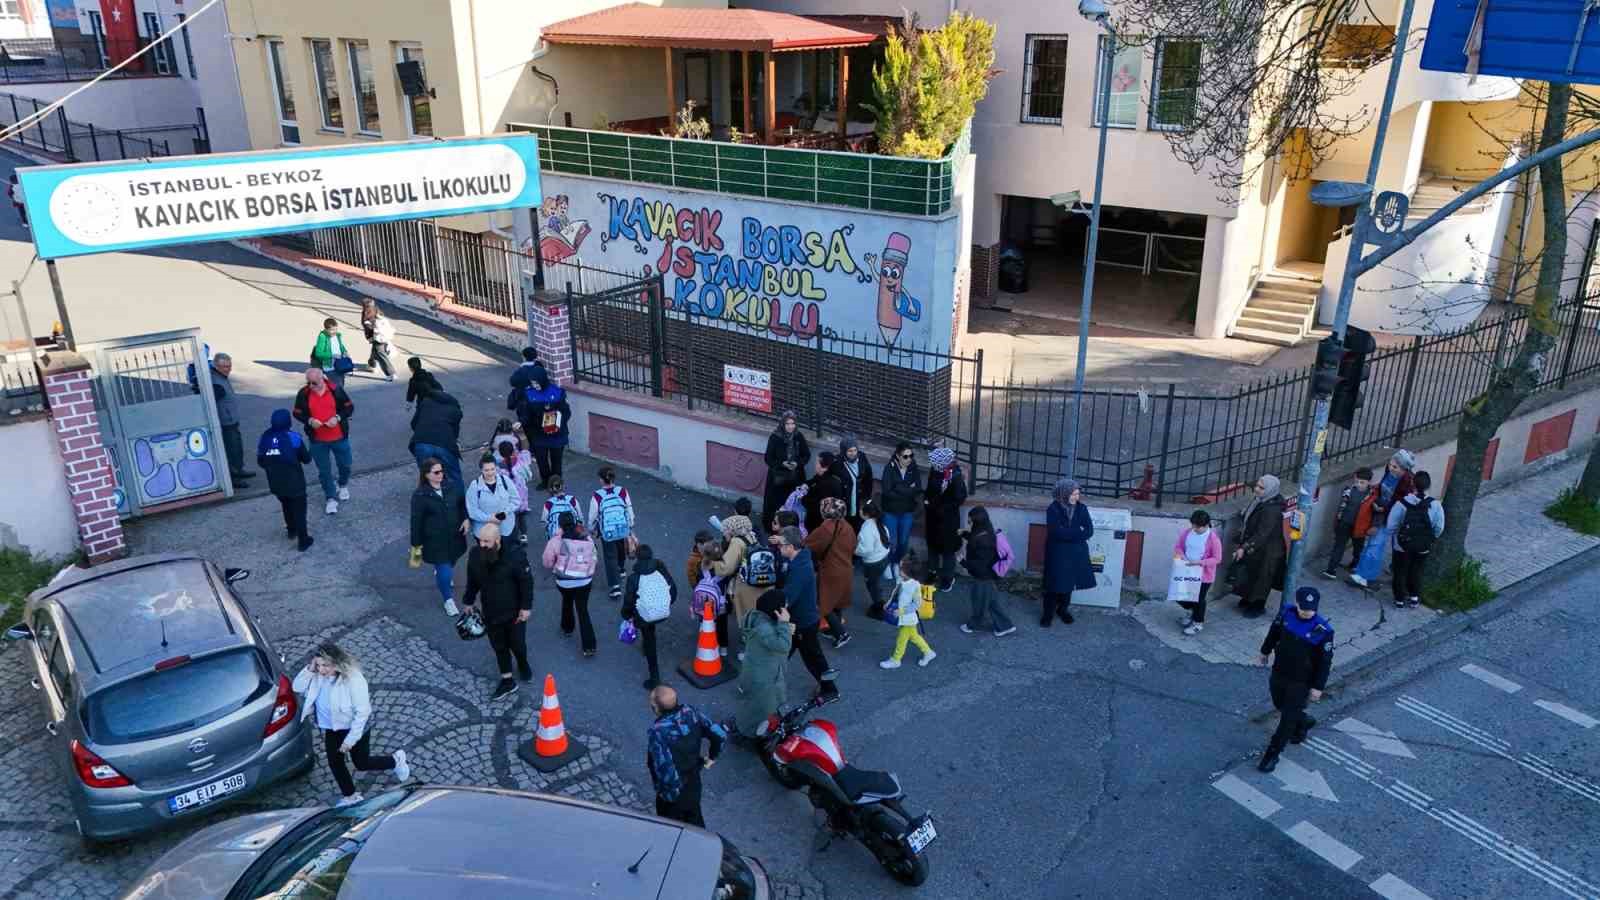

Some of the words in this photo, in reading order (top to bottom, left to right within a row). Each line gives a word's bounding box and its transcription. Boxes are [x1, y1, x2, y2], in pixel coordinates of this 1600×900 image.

[128, 176, 232, 197] İSTANBUL
[247, 169, 323, 187] BEYKOZ
[135, 198, 239, 229] KAVACIK
[245, 192, 318, 218] BORSA
[321, 182, 418, 211] İSTANBUL
[423, 173, 511, 201] İLKOKULU
[609, 196, 724, 251] KAVACIK
[742, 216, 858, 274] BORSA
[657, 235, 827, 301] İSTANBUL
[176, 794, 191, 808] 34
[196, 784, 217, 801] EIP
